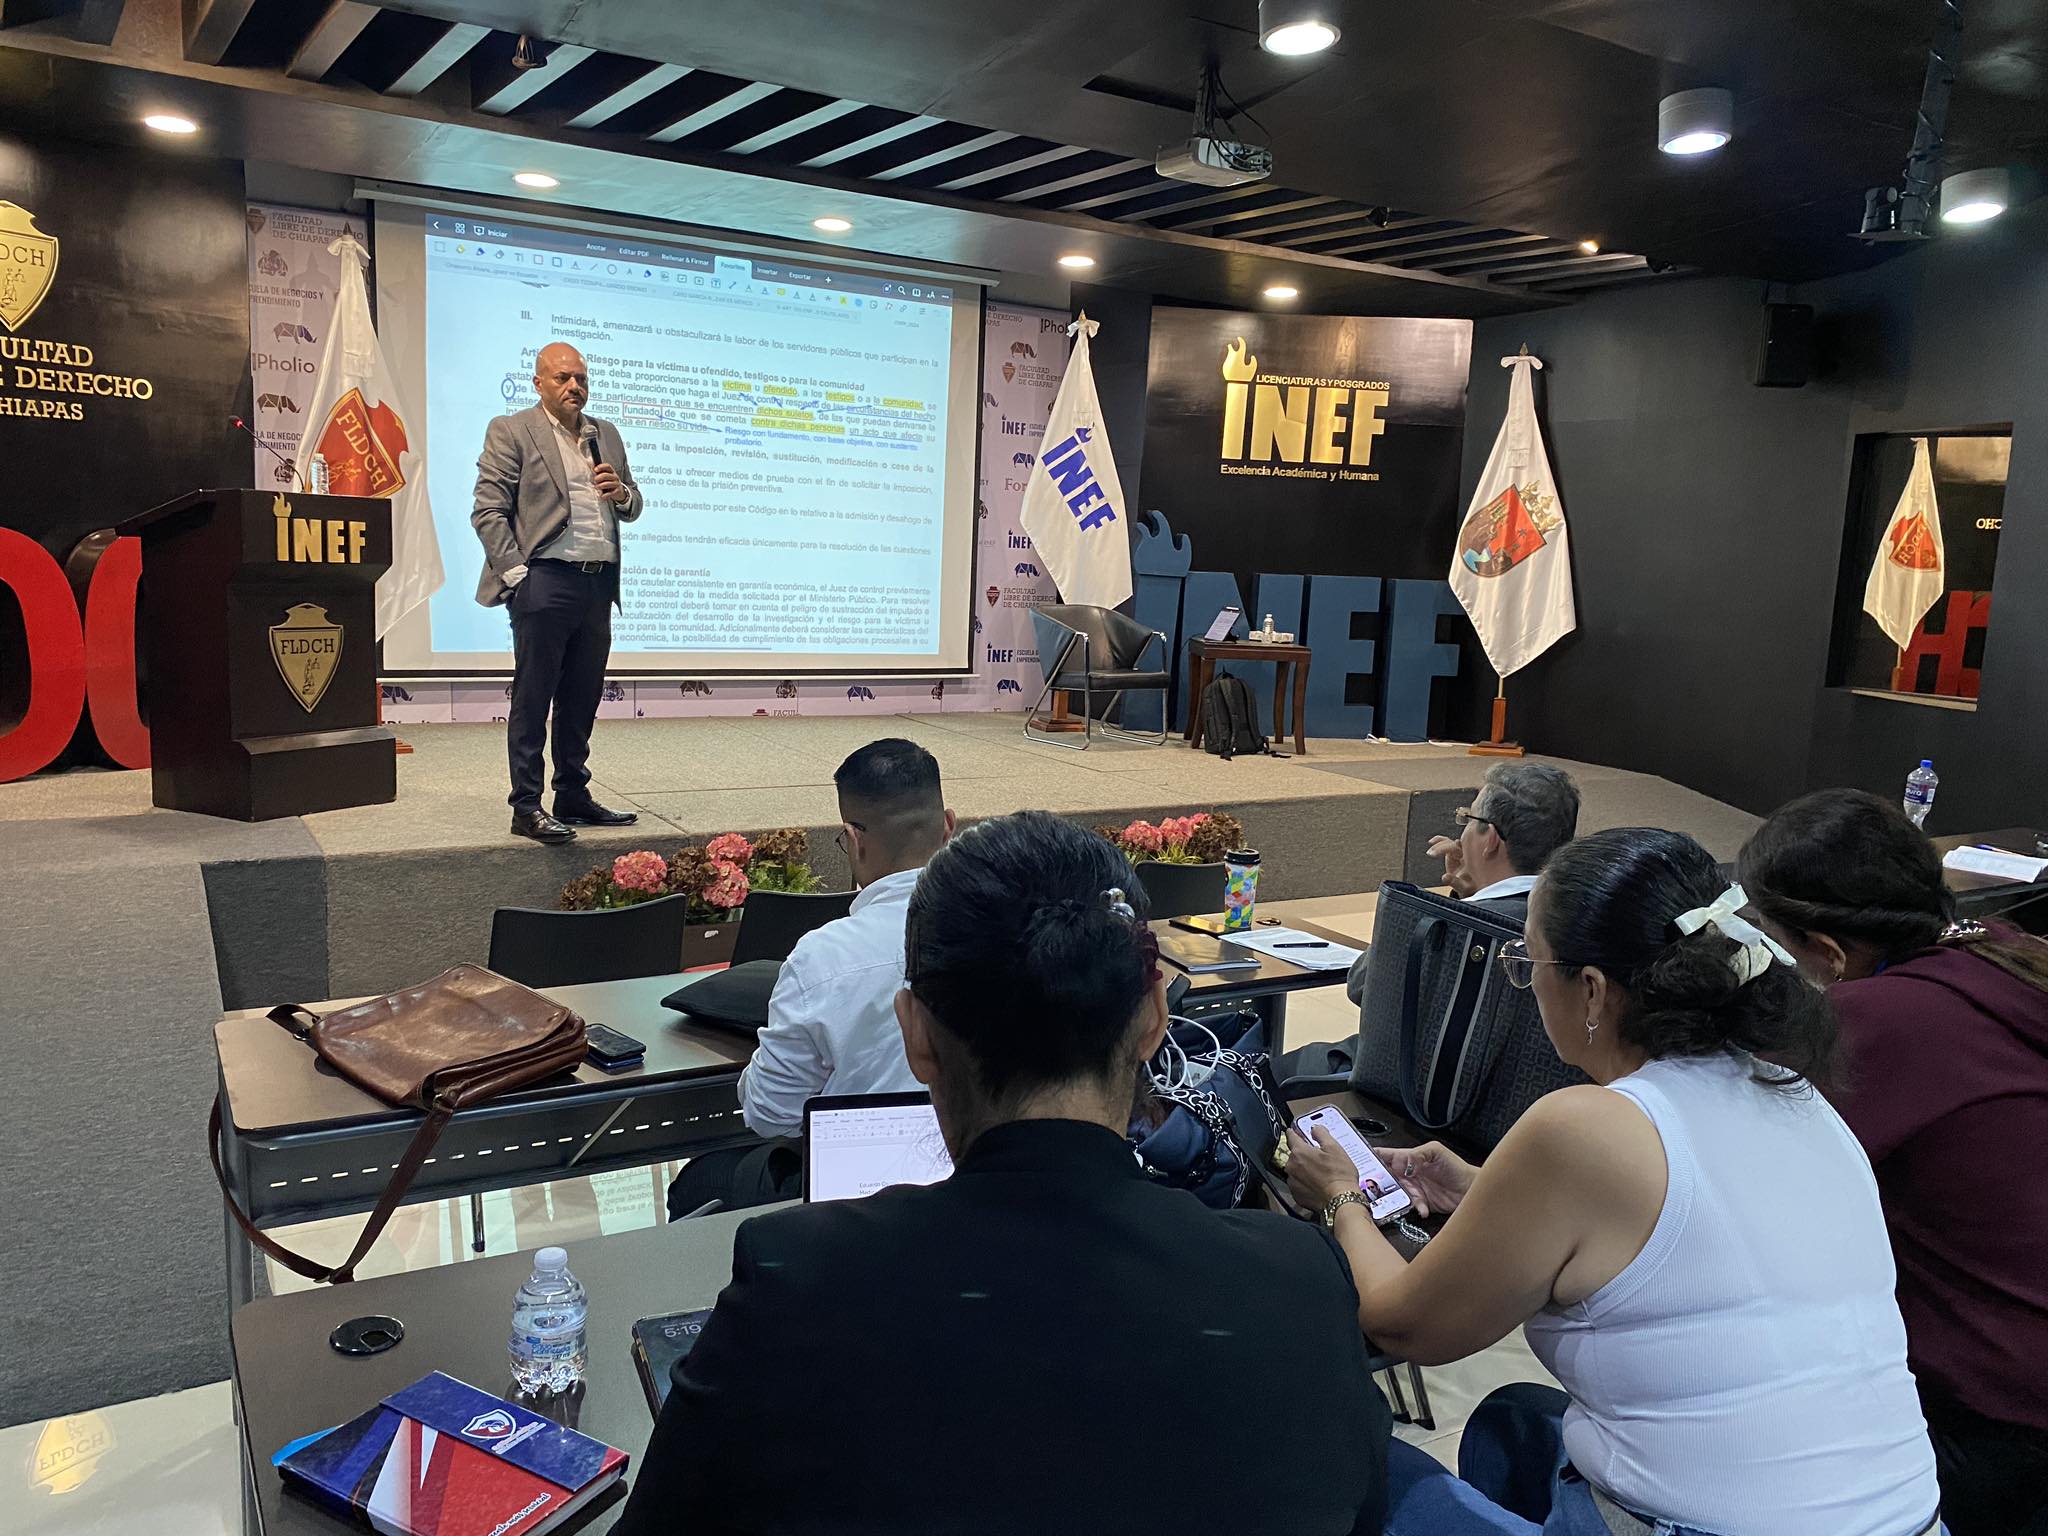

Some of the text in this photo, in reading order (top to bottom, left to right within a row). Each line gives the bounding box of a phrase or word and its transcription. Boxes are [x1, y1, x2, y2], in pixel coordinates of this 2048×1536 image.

[272, 212, 323, 226] FACULTAD
[272, 221, 299, 232] LIBRE
[300, 225, 315, 234] DE
[272, 230, 329, 245] DE CHIAPAS
[281, 288, 318, 300] NEGOCIOS
[319, 291, 324, 300] Y
[520, 309, 533, 320] III.
[551, 313, 599, 329] Intimidará,
[602, 319, 652, 334] amenazará
[665, 326, 720, 342] obstaculizará
[734, 335, 755, 346] labor
[772, 339, 783, 349] los
[786, 341, 826, 354] servidores
[829, 346, 862, 360] públicos
[864, 352, 878, 362] que
[881, 352, 917, 367] participan
[551, 325, 613, 343] investigación.
[586, 353, 619, 368] Riesgo
[622, 359, 643, 370] para
[645, 359, 654, 369] la
[656, 360, 689, 373] víctima
[691, 366, 698, 374] u
[700, 365, 742, 379] ofendido,
[743, 370, 778, 384] testigos
[788, 376, 807, 387] para
[809, 377, 817, 386] la
[818, 378, 864, 391] comunidad
[15, 366, 153, 400] DERECHO
[1256, 374, 1390, 391] LICENCIATURAS Y POSGRADOS
[266, 432, 276, 441] DE
[335, 409, 387, 491] FLDCH
[1220, 464, 1380, 481] Excelencia Académica y Humana
[1003, 587, 1036, 595] FACULTAD
[280, 638, 335, 655] FLDCH
[664, 1323, 702, 1338] 5:19
